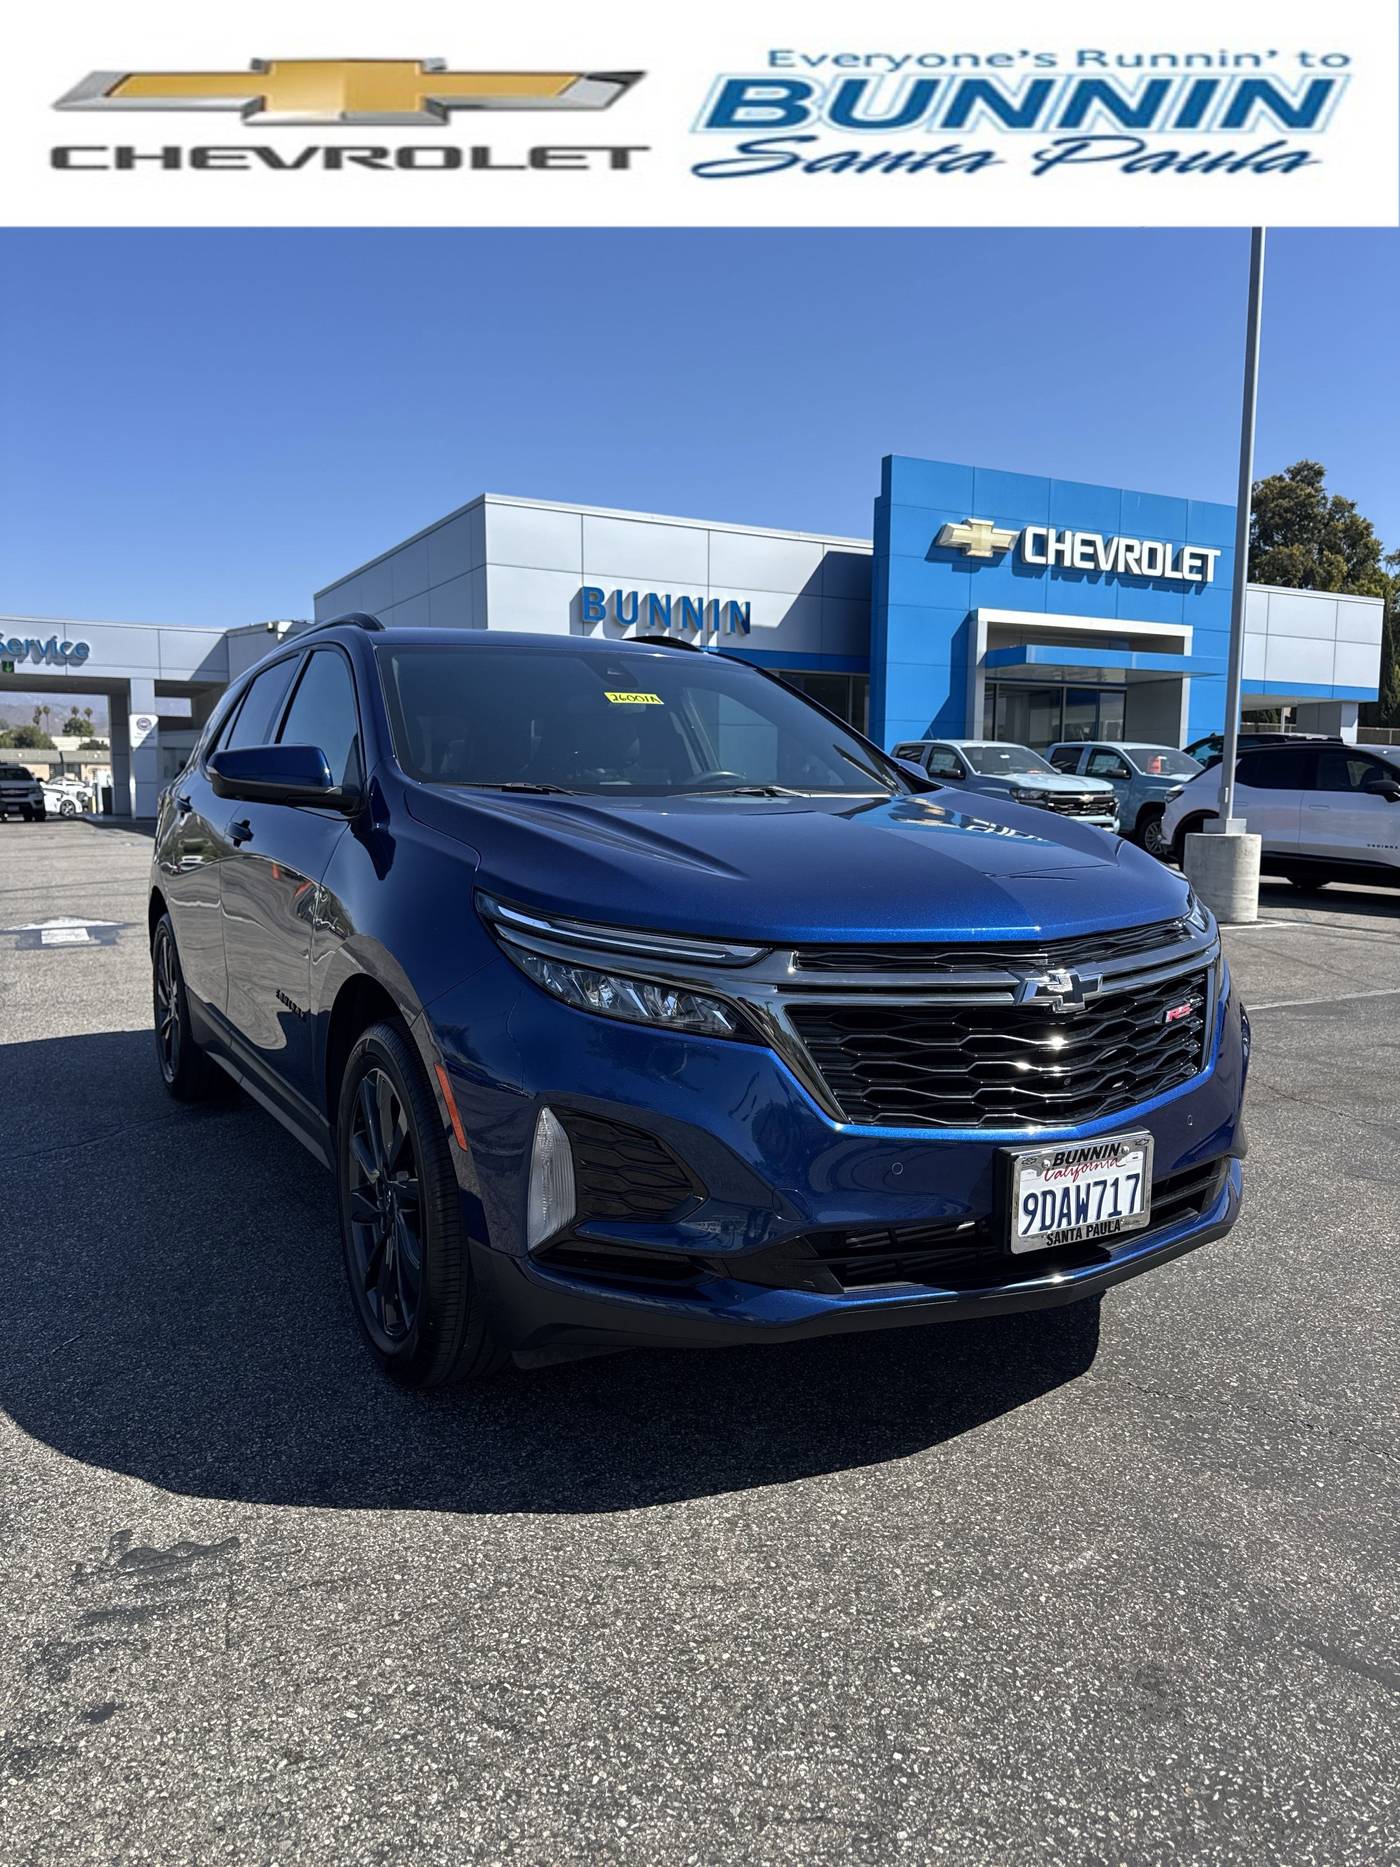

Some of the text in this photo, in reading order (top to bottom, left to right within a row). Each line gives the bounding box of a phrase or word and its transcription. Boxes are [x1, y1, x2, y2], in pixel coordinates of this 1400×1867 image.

[1023, 526, 1221, 582] CHEVROLET
[581, 586, 751, 635] BUNNIN
[1052, 1143, 1121, 1167] BUNNIN
[1021, 1172, 1141, 1236] 9DAW717
[1046, 1218, 1121, 1247] SANTA PAULA
